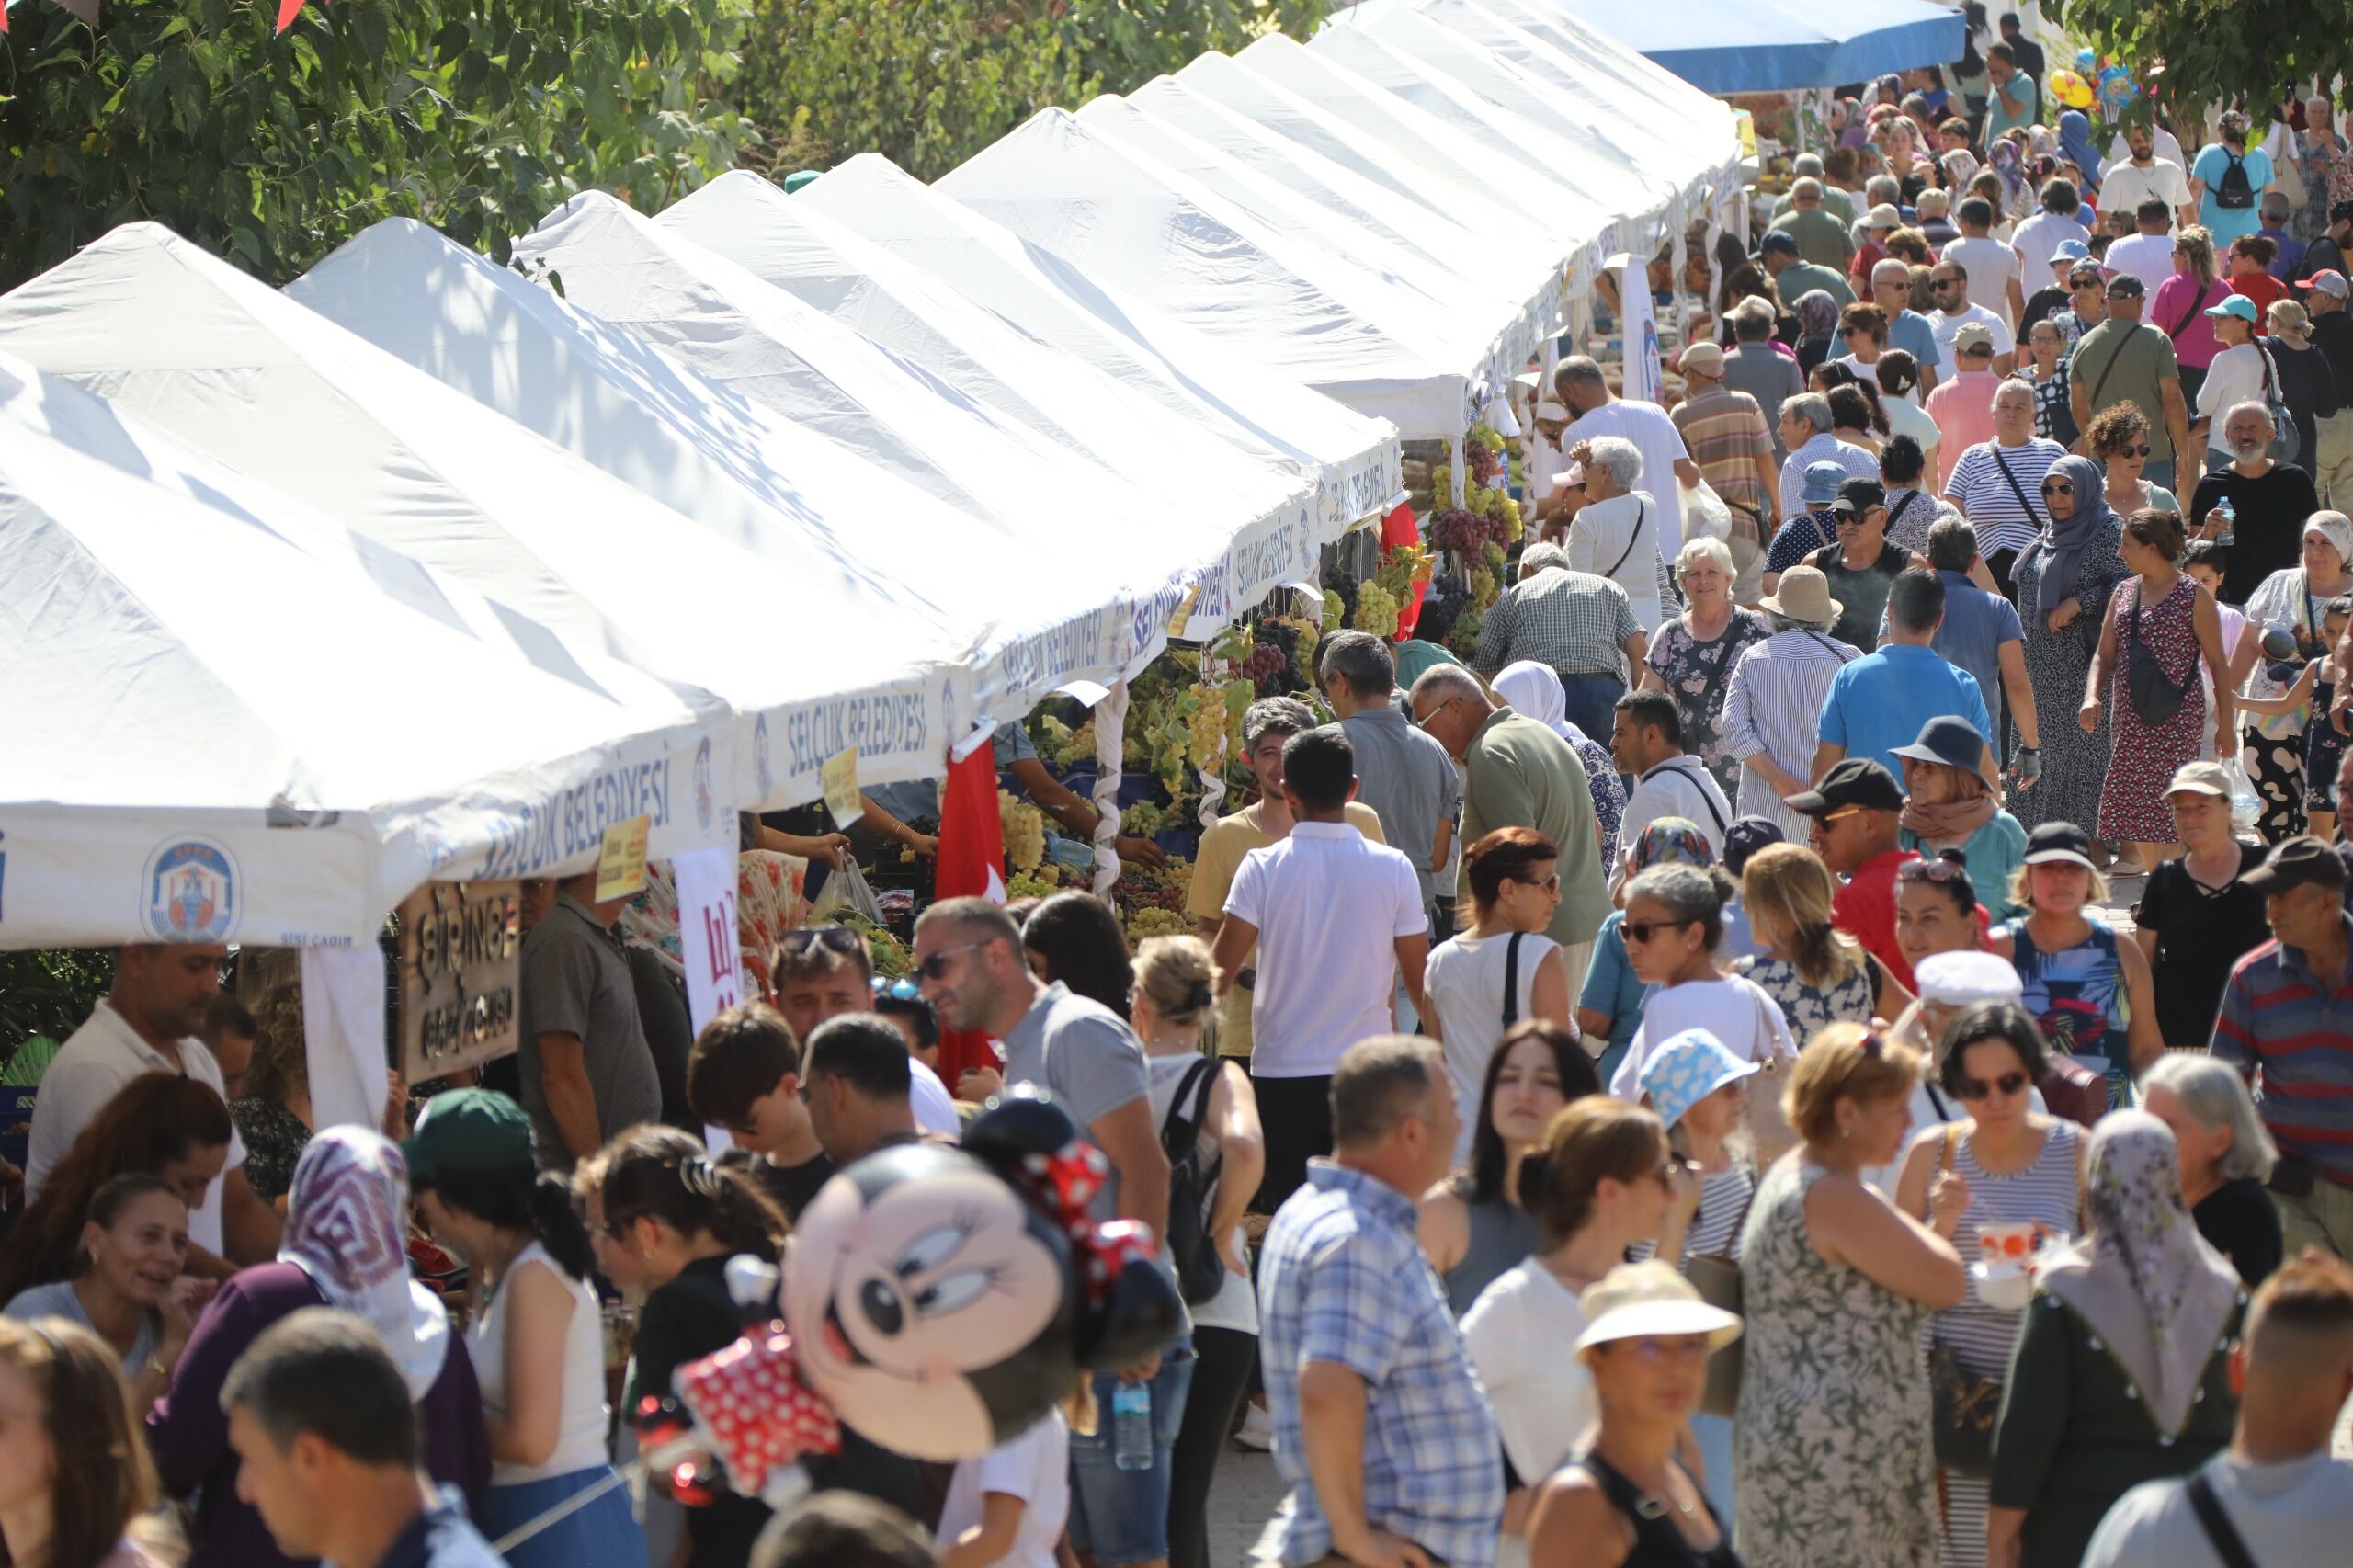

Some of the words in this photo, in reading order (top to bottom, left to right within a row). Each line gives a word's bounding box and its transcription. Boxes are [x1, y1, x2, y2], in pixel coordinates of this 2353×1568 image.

[788, 699, 846, 786] SELÇUK
[847, 678, 926, 758] BELEDİYESİ
[563, 739, 670, 857] BELEDİYESİ
